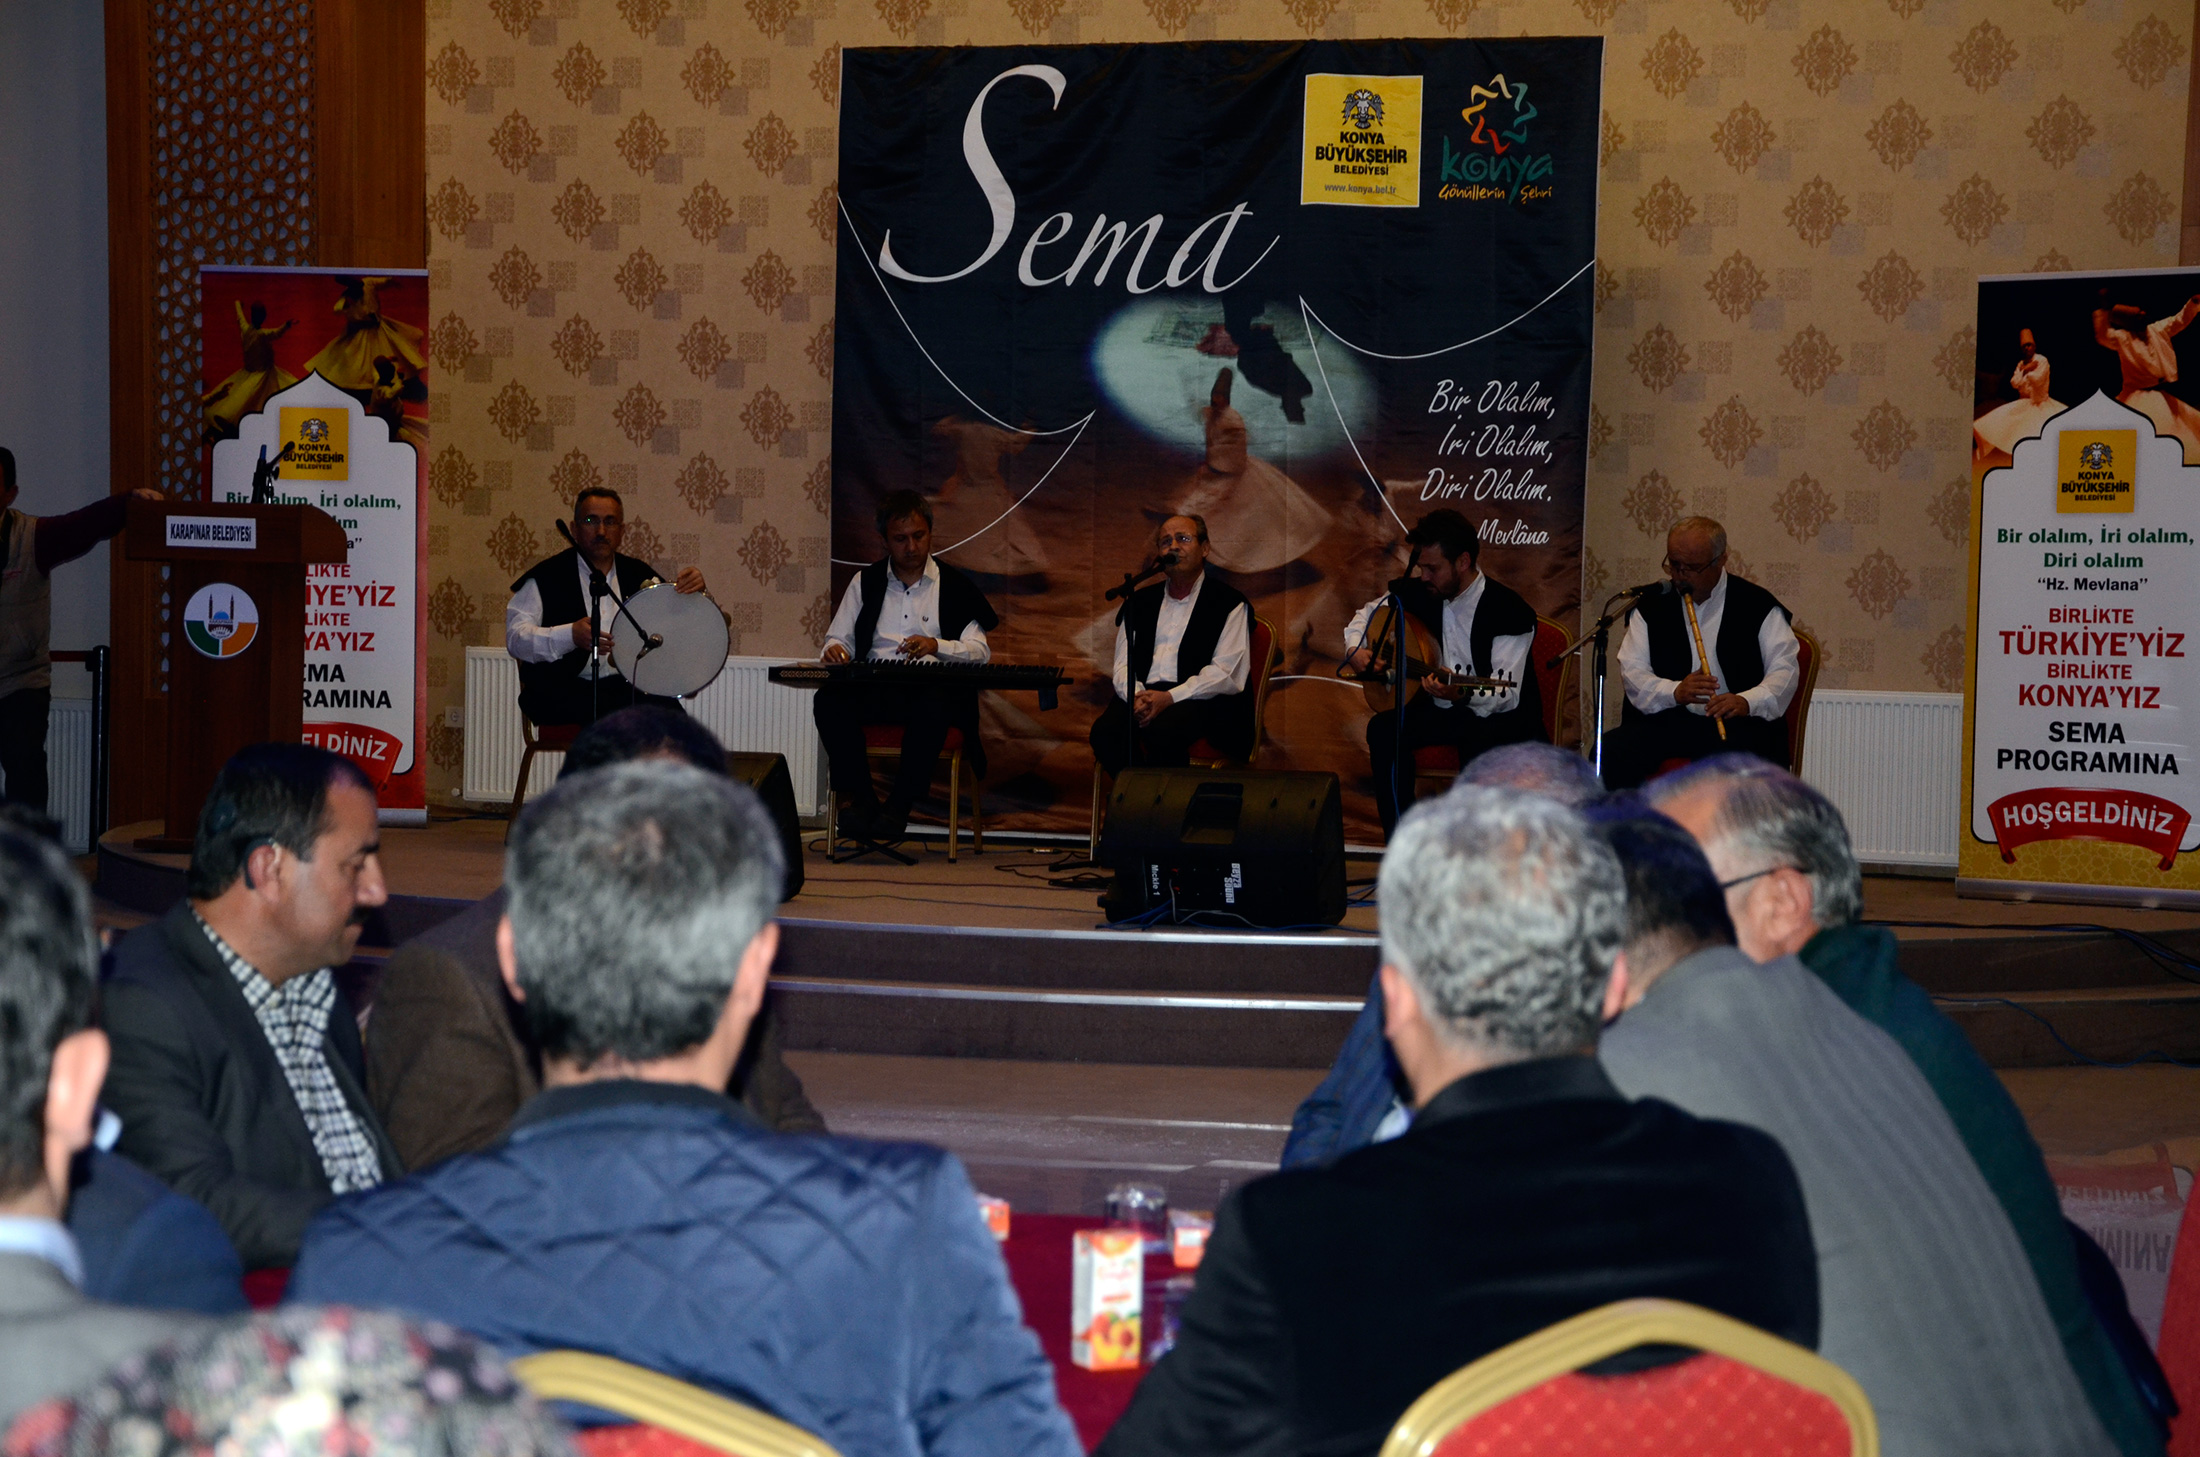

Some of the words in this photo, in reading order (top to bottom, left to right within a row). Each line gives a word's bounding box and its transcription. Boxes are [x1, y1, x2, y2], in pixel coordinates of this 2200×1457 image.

[1339, 131, 1385, 145] KONYA
[1315, 143, 1408, 165] BÜYÜKŞEHİR
[878, 64, 1280, 294] Sema
[1334, 163, 1389, 176] BELEDİYESİ
[1324, 182, 1397, 195] www.konya.bel.tr
[1438, 183, 1506, 201] Gönüllerin
[1521, 184, 1552, 204] Şehri
[1428, 379, 1471, 413] Bir
[1477, 380, 1556, 420] Olalım,
[298, 443, 331, 452] KONYA
[1475, 424, 1553, 464] Olalım,
[283, 450, 345, 463] BÜYÜKŞEHİR
[1420, 467, 1474, 501] Diri
[1474, 468, 1552, 502] Olalım.
[2077, 472, 2114, 480] KONYA
[2061, 481, 2130, 493] BÜYÜKŞEHİR
[2075, 493, 2116, 501] BELEDİYESİ
[226, 491, 249, 503] Bir
[320, 490, 338, 508] İri
[344, 494, 402, 510] olalım,
[170, 523, 211, 541] KARAPINAR
[1477, 518, 1550, 545] Mevlâna
[1997, 528, 2022, 543] Bir
[2029, 528, 2093, 545] olalım,
[2101, 524, 2121, 543] İri
[2128, 528, 2194, 545] olalım,
[2044, 552, 2077, 568] Diri
[2084, 552, 2143, 568] olalım
[2038, 578, 2069, 591] “Hz.
[2074, 578, 2148, 591] Mevlana”
[2049, 604, 2134, 624] BİRLİKTE
[1999, 625, 2185, 657] TÜRKİYE’YİZ
[303, 664, 345, 682] MA
[2047, 660, 2133, 680] BİRLİKTE
[2019, 684, 2161, 709] KONYA’YIZ
[2048, 721, 2126, 744] SEMA
[1997, 749, 2179, 775] PROGRAMINA
[2003, 799, 2175, 836] HOŞGELDİNİZ
[1230, 863, 1242, 888] Beyza
